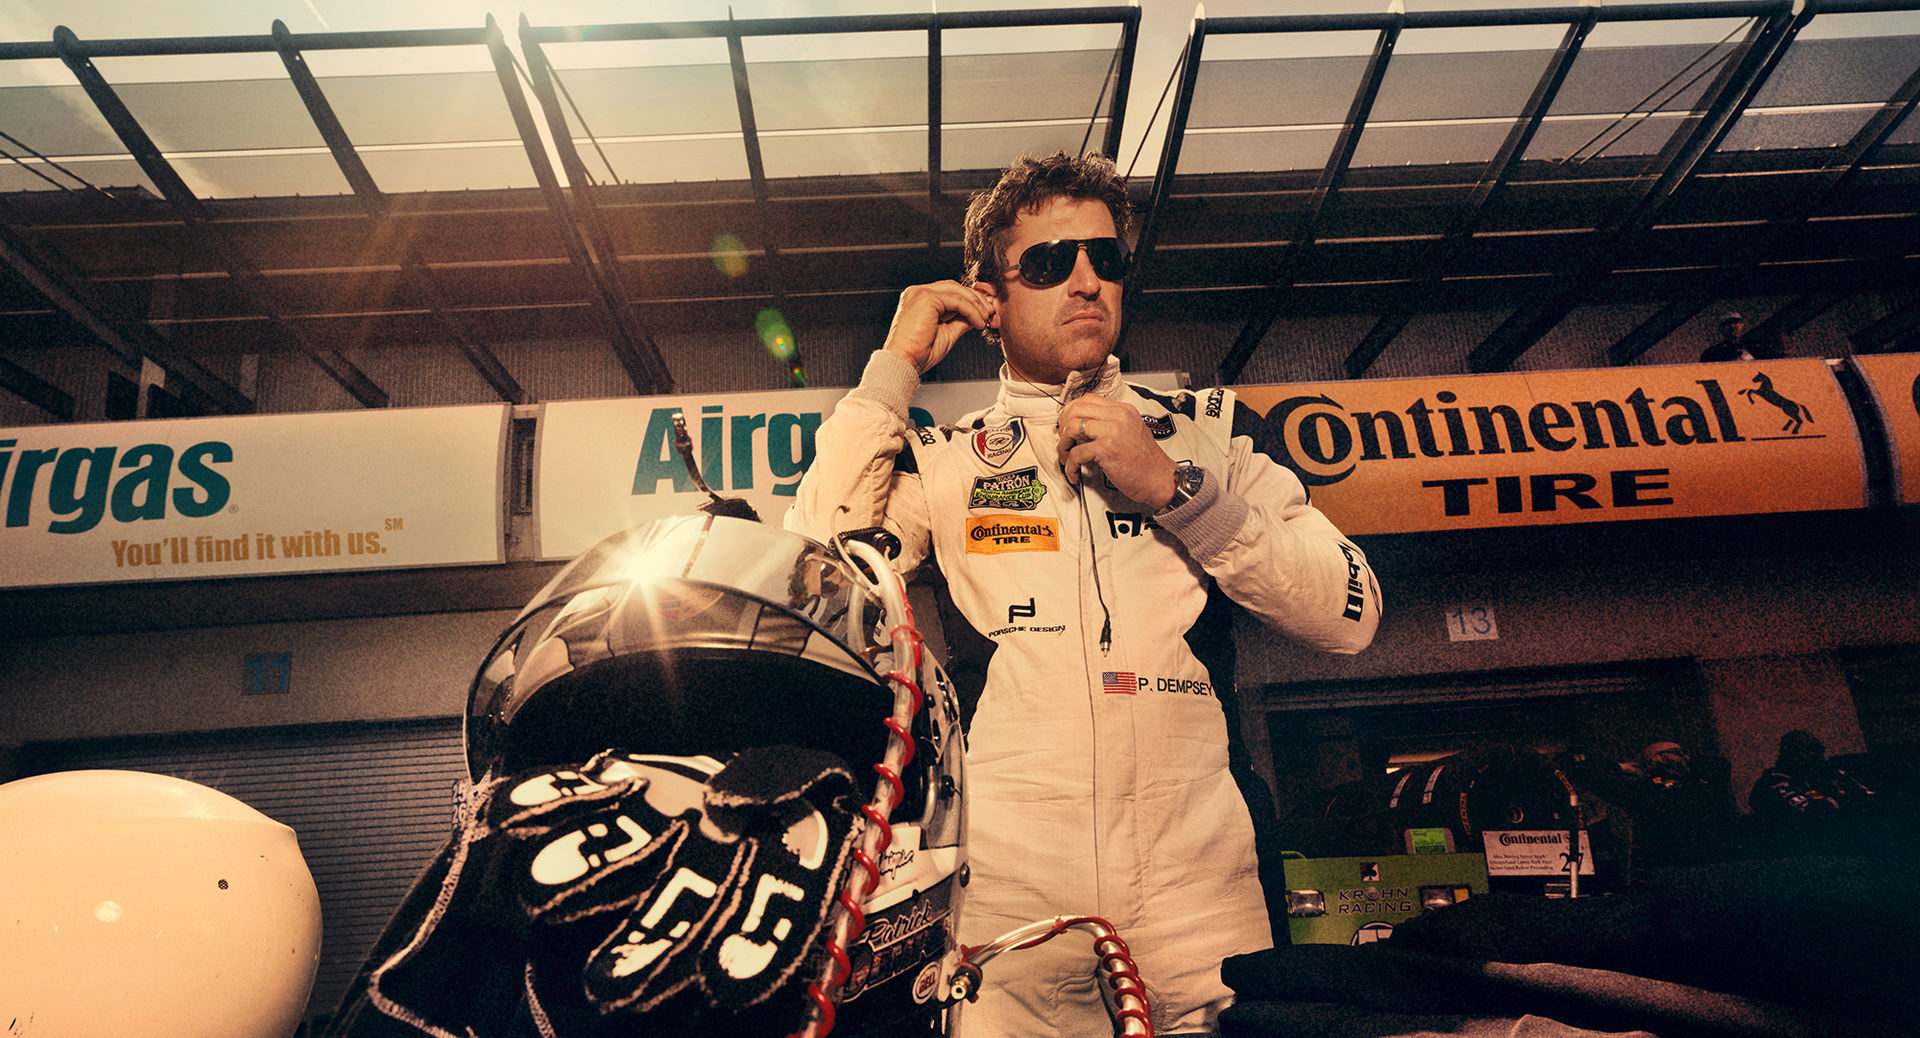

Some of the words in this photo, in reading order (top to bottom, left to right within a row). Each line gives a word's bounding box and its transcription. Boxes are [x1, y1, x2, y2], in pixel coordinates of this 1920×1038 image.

[1263, 379, 1746, 486] Continental
[631, 405, 935, 497] Airg
[1422, 468, 1674, 517] TIRE
[971, 524, 1042, 540] Continental
[992, 536, 1031, 545] TIRE
[111, 536, 189, 567] You'll
[195, 534, 249, 563] find
[256, 533, 276, 560] it
[281, 530, 341, 559] with
[347, 532, 387, 556] us.
[988, 626, 1027, 638] PORSCHE
[1029, 625, 1066, 633] DESIGN
[1451, 607, 1492, 635] 13
[245, 652, 290, 693] 11
[1138, 677, 1153, 692] P.
[1157, 678, 1214, 696] DEMPSEY
[1499, 833, 1562, 846] Continental
[1338, 901, 1412, 914] RACING
[919, 971, 936, 994] BELL
